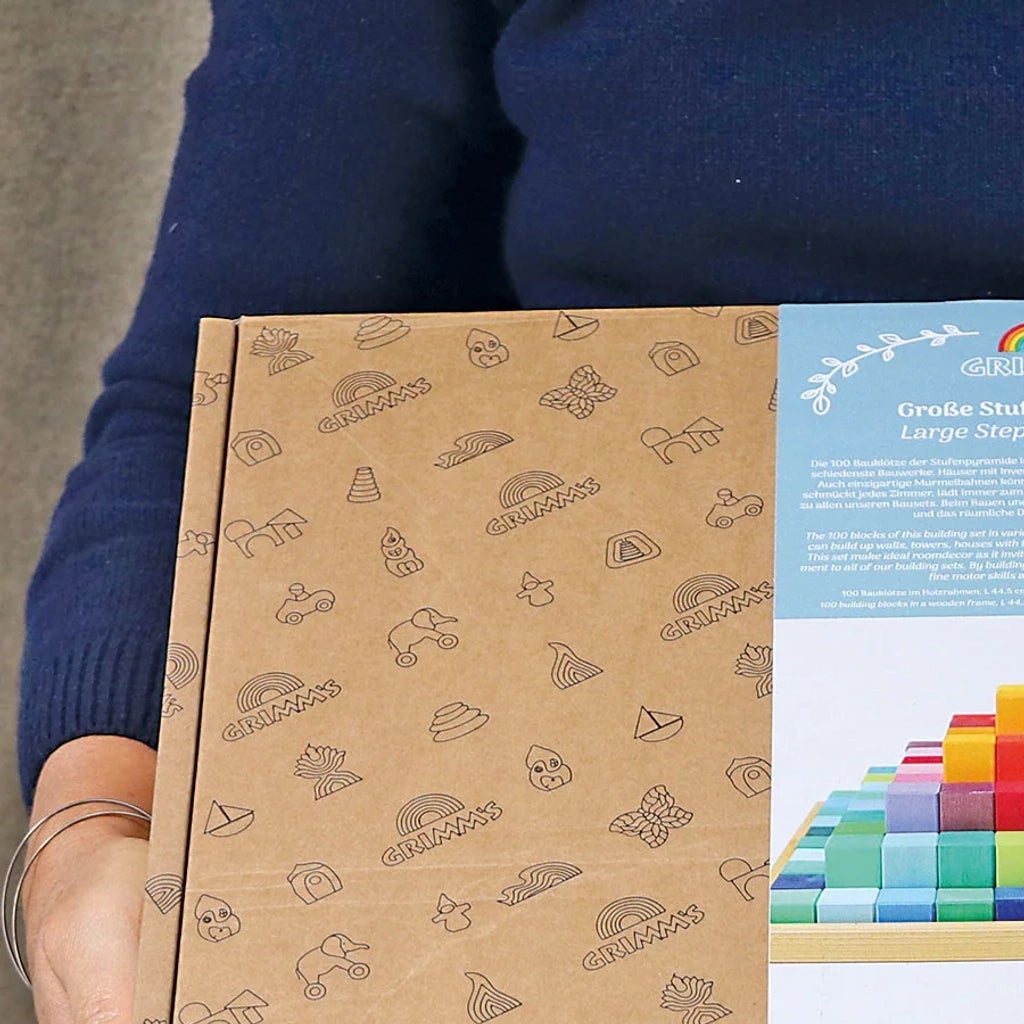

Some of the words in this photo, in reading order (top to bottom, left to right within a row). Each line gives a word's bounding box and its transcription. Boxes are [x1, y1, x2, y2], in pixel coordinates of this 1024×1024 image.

[318, 377, 432, 433] GRIMM'S
[898, 402, 973, 417] Große
[901, 424, 968, 443] Large
[811, 459, 827, 467] Die
[831, 459, 850, 467] 100
[853, 458, 906, 467] Bauklötze
[908, 458, 926, 466] der
[930, 456, 1017, 468] Stufenpyramide
[811, 468, 875, 478] schiedenste
[937, 467, 976, 476] Häuser
[980, 467, 997, 475] mit
[817, 479, 845, 488] Auch
[847, 478, 912, 489] einzigartige
[914, 477, 997, 486] Murmelbahnen
[802, 489, 855, 498] schmückt
[858, 489, 886, 500] jedes
[960, 488, 997, 496] immer
[486, 477, 600, 536] GRIMM'S
[815, 500, 842, 509] allen
[941, 498, 968, 507] Beim
[970, 498, 1005, 507] Bauen
[913, 509, 934, 518] und
[936, 509, 956, 518] das
[959, 508, 1014, 517] räumliche
[806, 531, 825, 540] The
[827, 531, 848, 539] 100
[849, 530, 886, 539] blocks
[901, 530, 922, 538] this
[922, 529, 968, 540] building
[830, 541, 858, 550] build
[953, 539, 993, 548] houses
[994, 539, 1019, 548] with
[808, 552, 830, 561] This
[831, 552, 848, 561] set
[850, 552, 882, 560] make
[882, 551, 910, 560] ideal
[911, 550, 974, 560] roomdecor
[800, 563, 828, 572] ment
[894, 562, 939, 572] building
[928, 572, 950, 580] fine
[951, 571, 986, 580] motor
[987, 571, 1016, 580] skills
[221, 679, 341, 742] GRIMM'S
[382, 800, 502, 866] GRIMM'S
[582, 904, 705, 971] GRIMM'S
